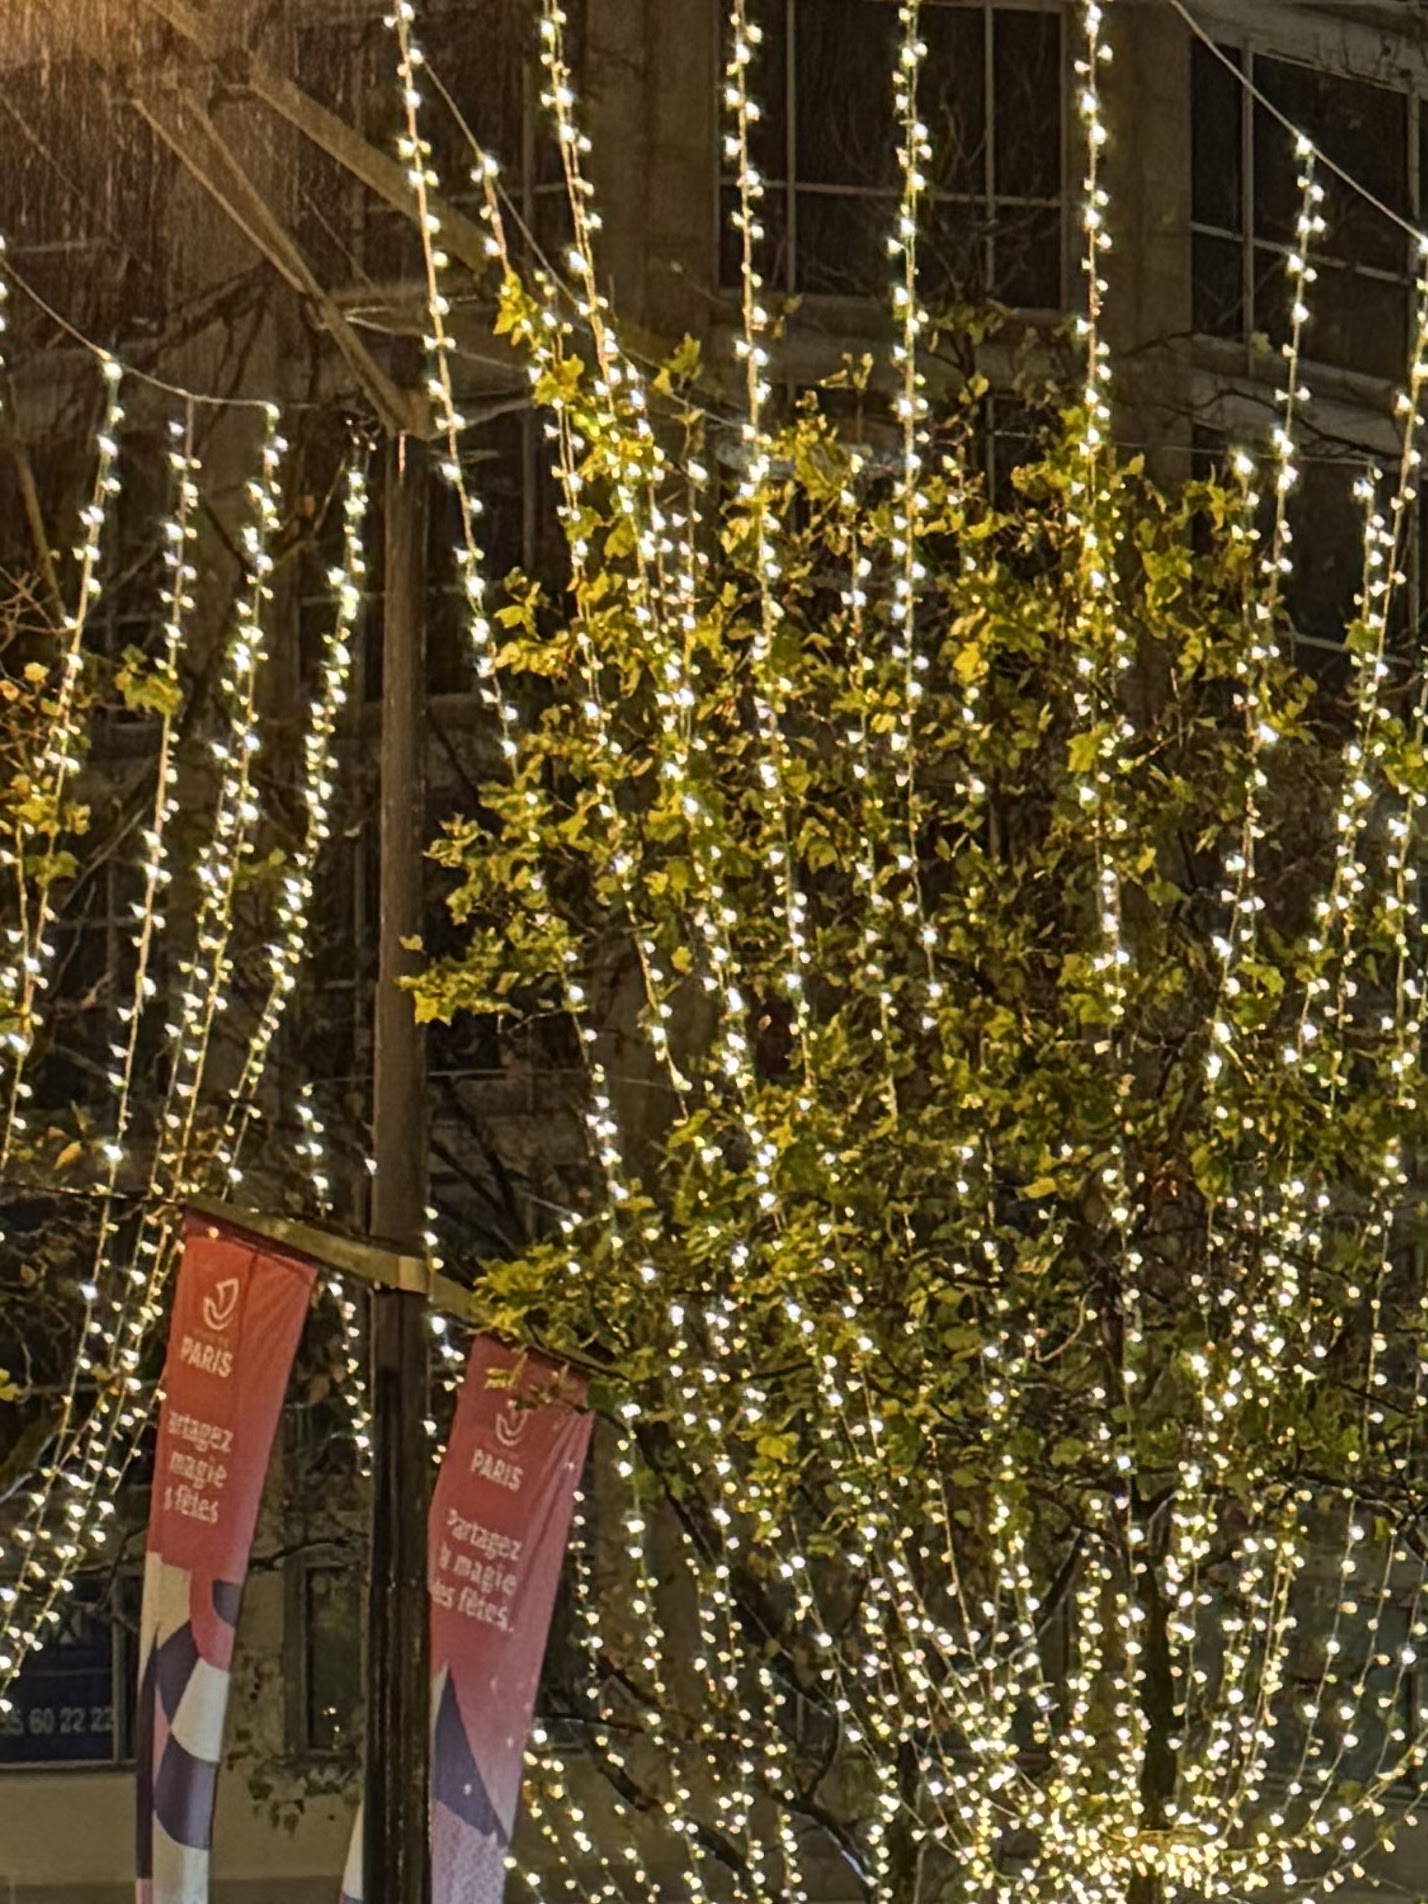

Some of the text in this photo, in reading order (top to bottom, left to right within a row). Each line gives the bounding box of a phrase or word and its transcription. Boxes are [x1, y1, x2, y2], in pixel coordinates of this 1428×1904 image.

[180, 1335, 234, 1378] PARIS
[168, 1410, 235, 1454] artagez
[470, 1448, 524, 1492] PARIS
[453, 1553, 518, 1598] magie
